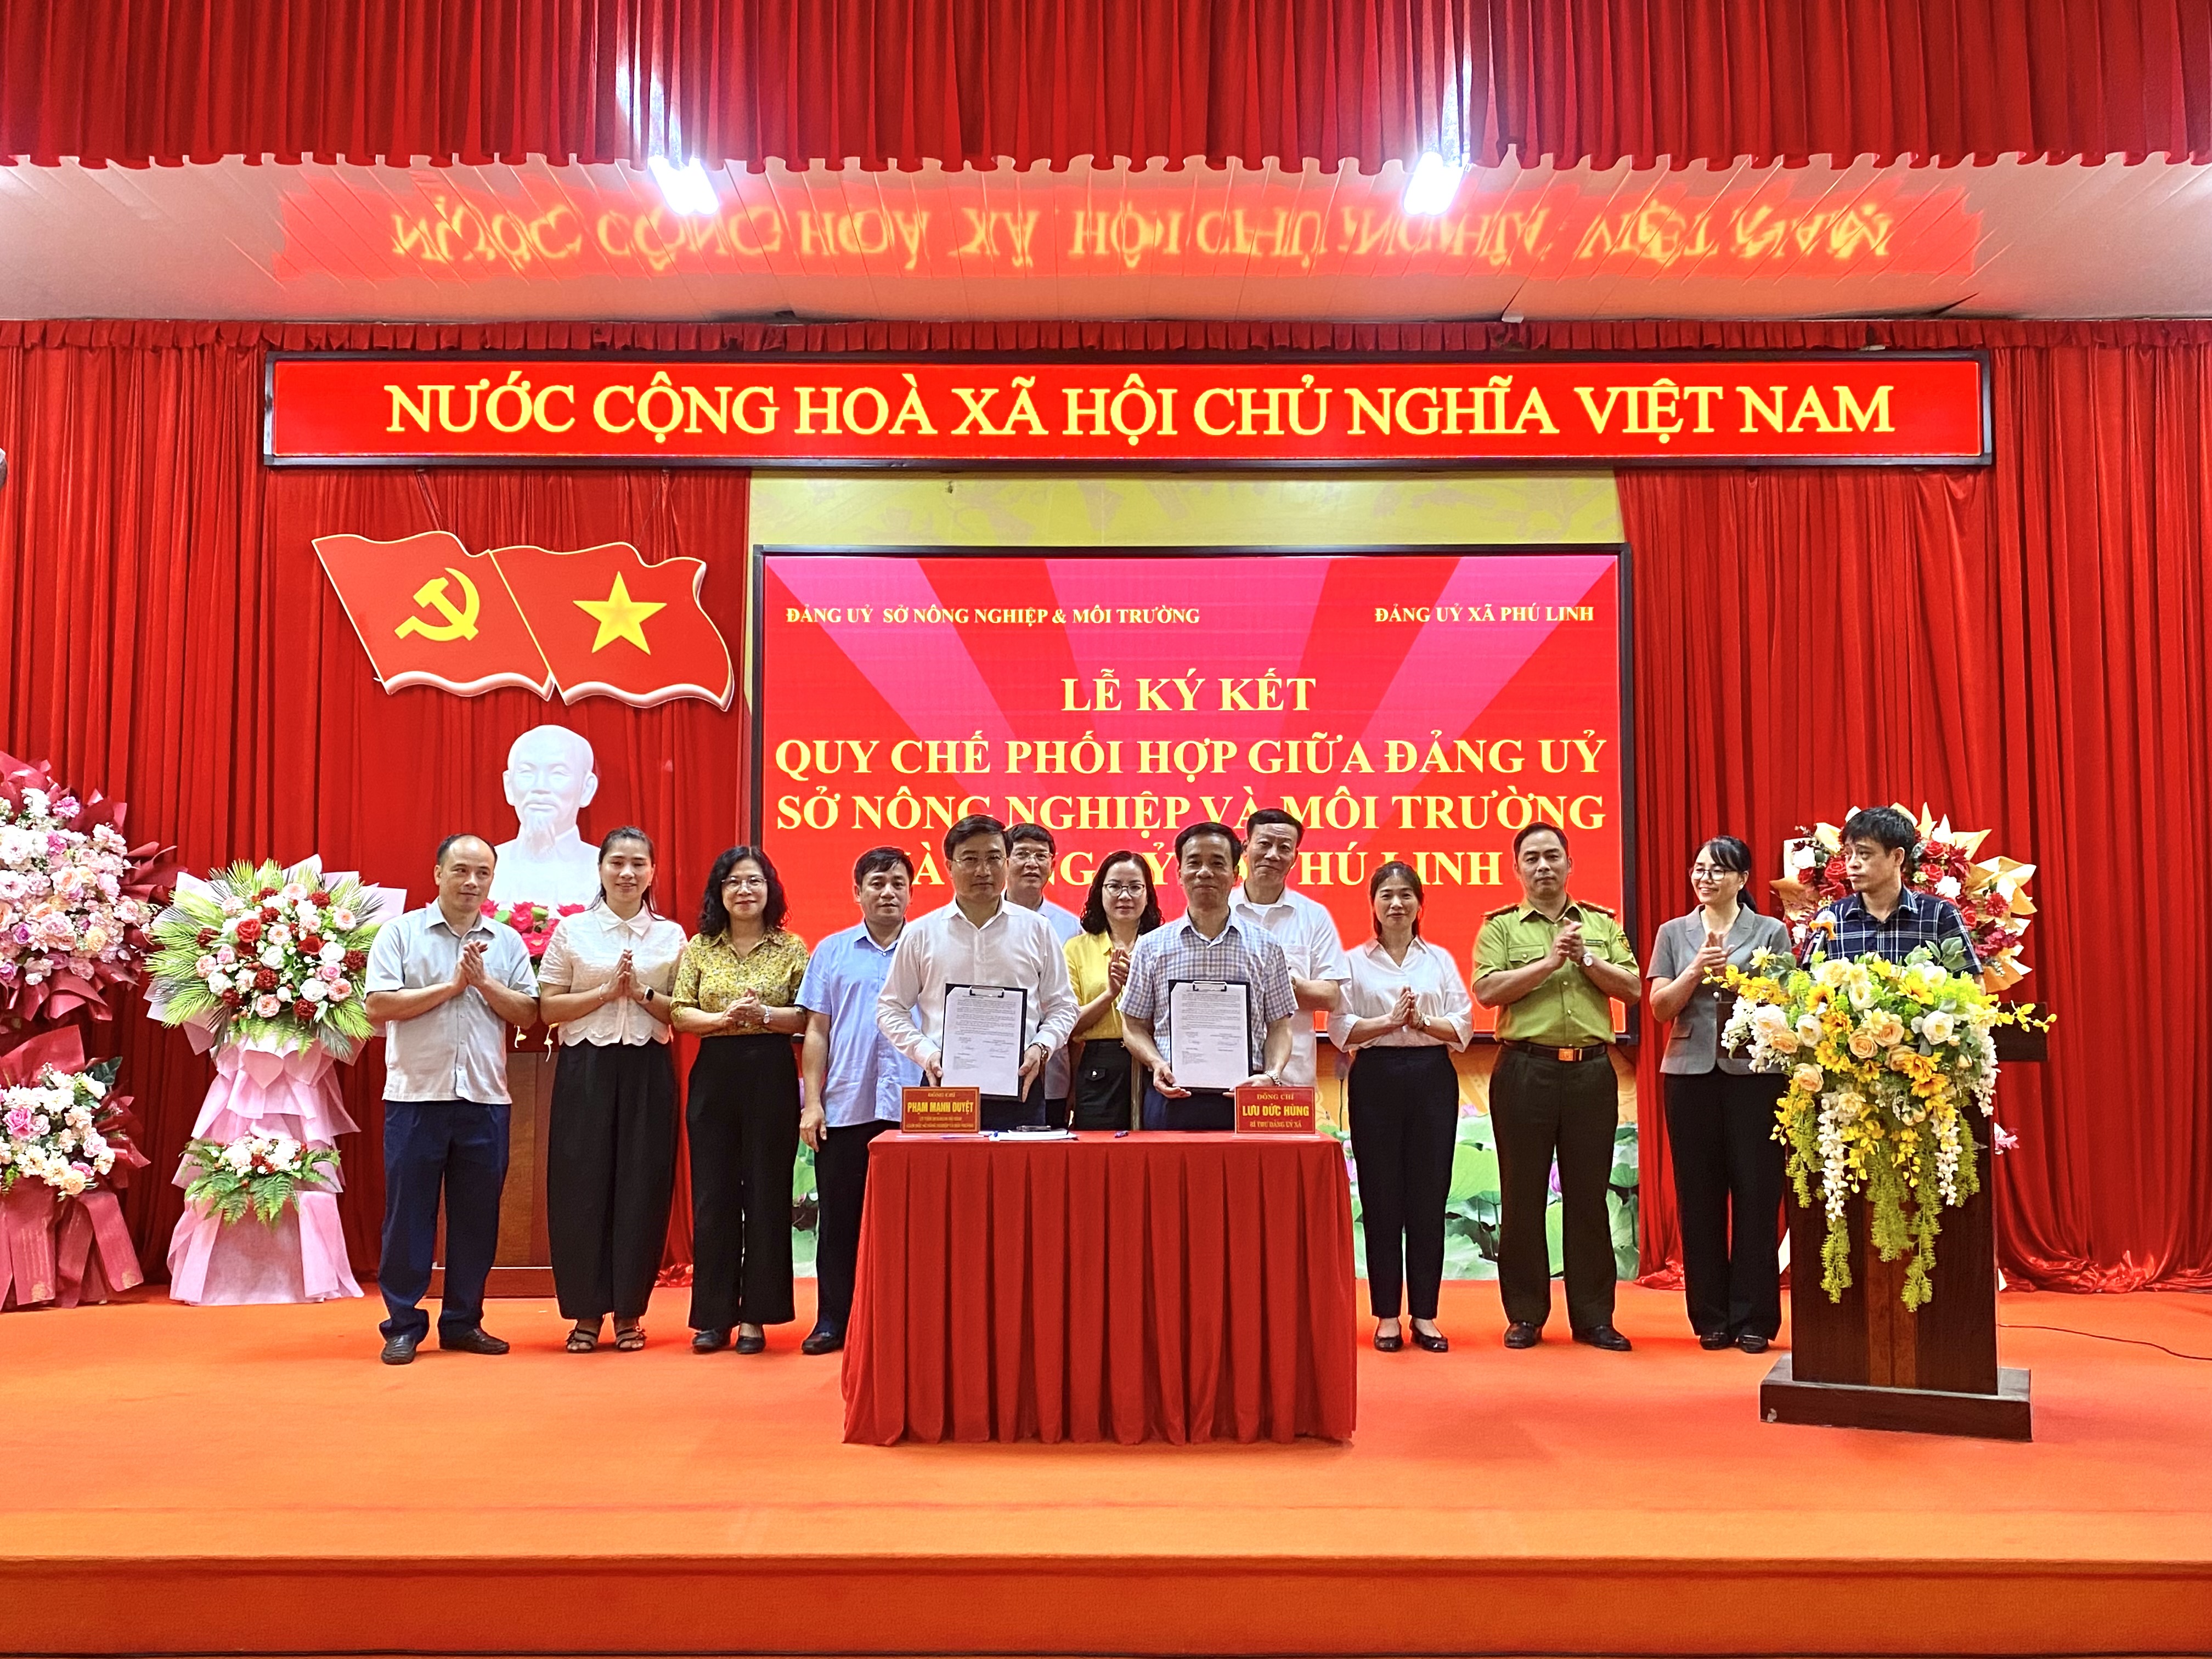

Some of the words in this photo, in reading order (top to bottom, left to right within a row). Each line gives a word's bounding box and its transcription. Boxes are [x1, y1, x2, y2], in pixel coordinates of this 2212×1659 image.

[384, 371, 575, 434] NƯỚC
[594, 371, 780, 443] CỘNG
[794, 374, 938, 435] HOÀ
[951, 376, 1048, 435] XÃ
[1062, 374, 1177, 445] HỘI
[1194, 374, 1332, 435] CHỦ
[1345, 375, 1559, 435] NGHĨA
[1574, 379, 1723, 444] VIỆT
[1736, 386, 1895, 432] NAM
[786, 604, 842, 623] ĐẢNG
[847, 604, 873, 623] UỶ
[883, 605, 909, 623] SỞ
[913, 604, 968, 623] NÔNG
[974, 607, 1048, 627] NGHIỆP
[1052, 608, 1066, 624] &
[1073, 605, 1111, 624] MÔI
[1116, 605, 1200, 624] TRƯỜNG
[1375, 603, 1430, 622] ĐẢNG
[1436, 602, 1463, 622] UỶ
[1468, 603, 1495, 622] XÃ
[1500, 602, 1540, 622] PHÚ
[1545, 606, 1594, 622] LINH
[1061, 668, 1121, 711] LỄ
[1135, 668, 1205, 711] KÝ
[1218, 668, 1316, 711] KẾT
[775, 740, 879, 781] QUY
[891, 730, 990, 774] CHẾ
[1005, 730, 1123, 774] PHỐI
[1137, 737, 1237, 783] HỢP
[1249, 731, 1375, 774] GIỮA
[1384, 729, 1525, 773] ĐẢNG
[1538, 729, 1607, 773] UỶ
[777, 786, 841, 830] SỞ
[1005, 791, 1190, 839] NGHIỆP
[1280, 786, 1379, 830] MÔI
[1391, 786, 1606, 830] TRƯỜNG
[904, 842, 945, 885] À
[1144, 842, 1174, 885] Ỷ
[1297, 842, 1368, 885] HÚ
[907, 1102, 928, 1115] PHẠM
[1242, 1104, 1260, 1116] LƯU
[1284, 1103, 1310, 1116] HÙNG
